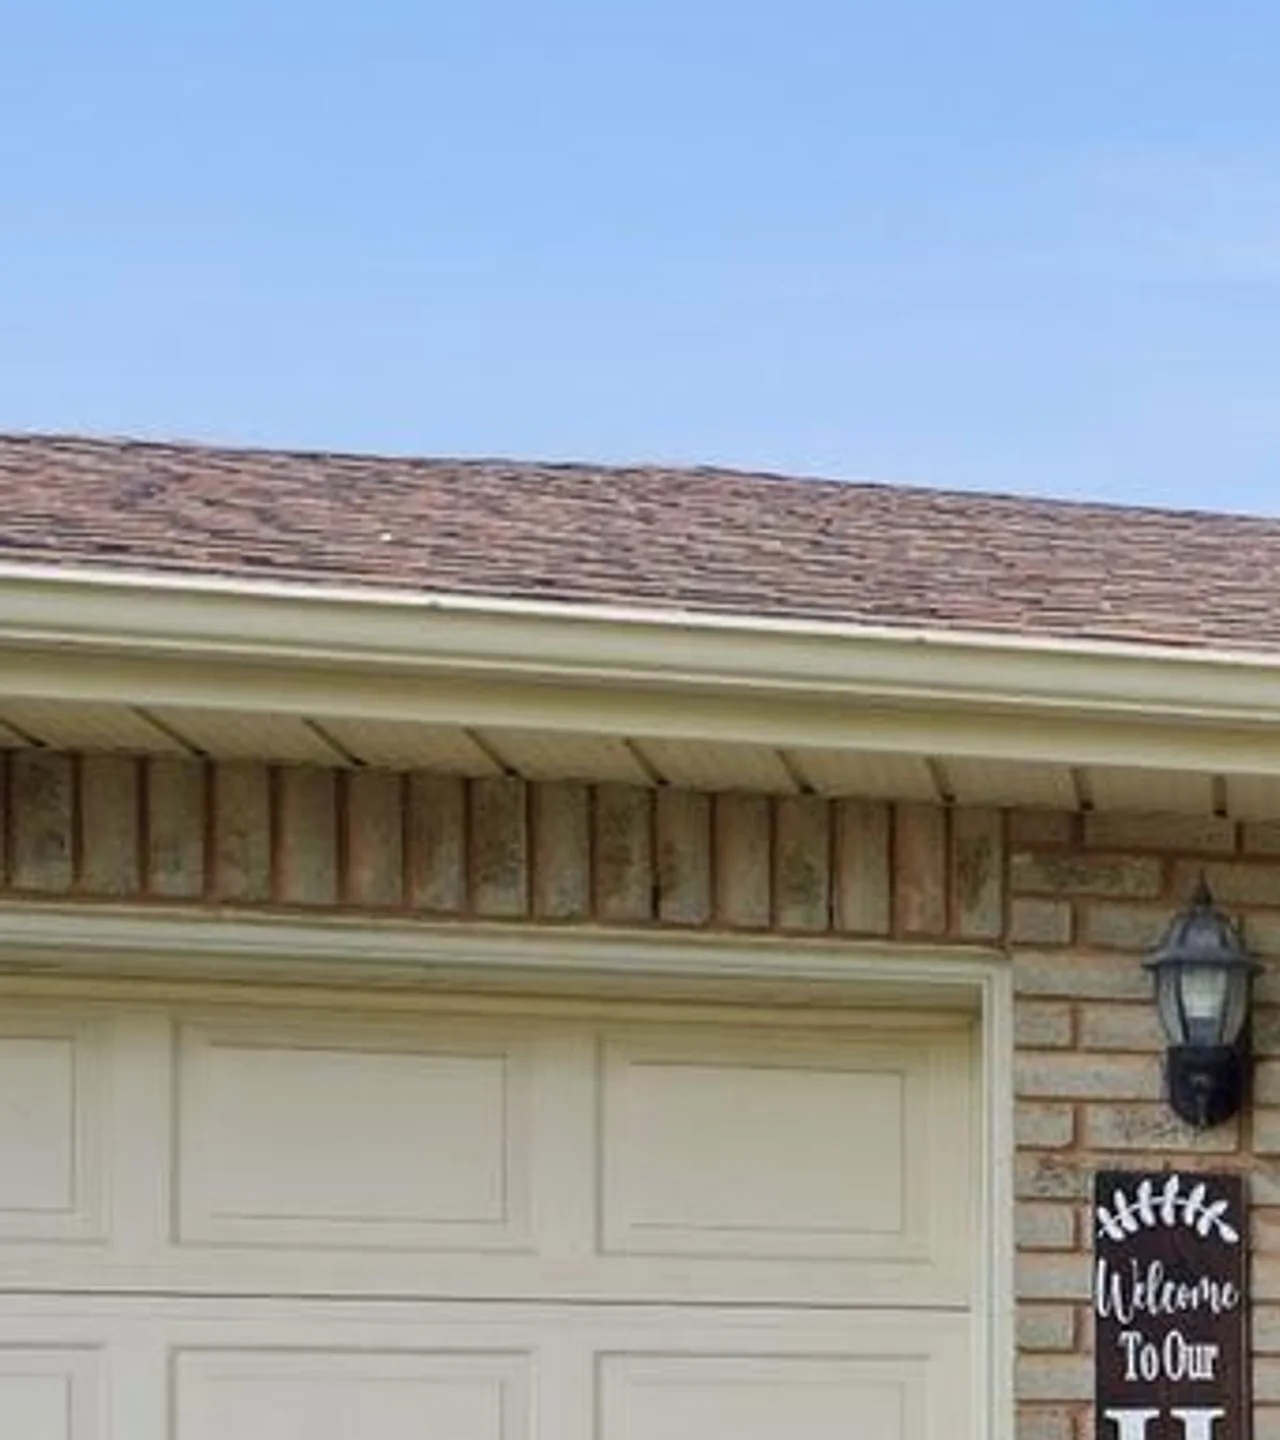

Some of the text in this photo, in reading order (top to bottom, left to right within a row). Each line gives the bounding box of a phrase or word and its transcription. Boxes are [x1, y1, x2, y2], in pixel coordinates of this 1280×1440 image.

[1097, 1258, 1240, 1324] Welcome
[1119, 1328, 1219, 1381] To Our
